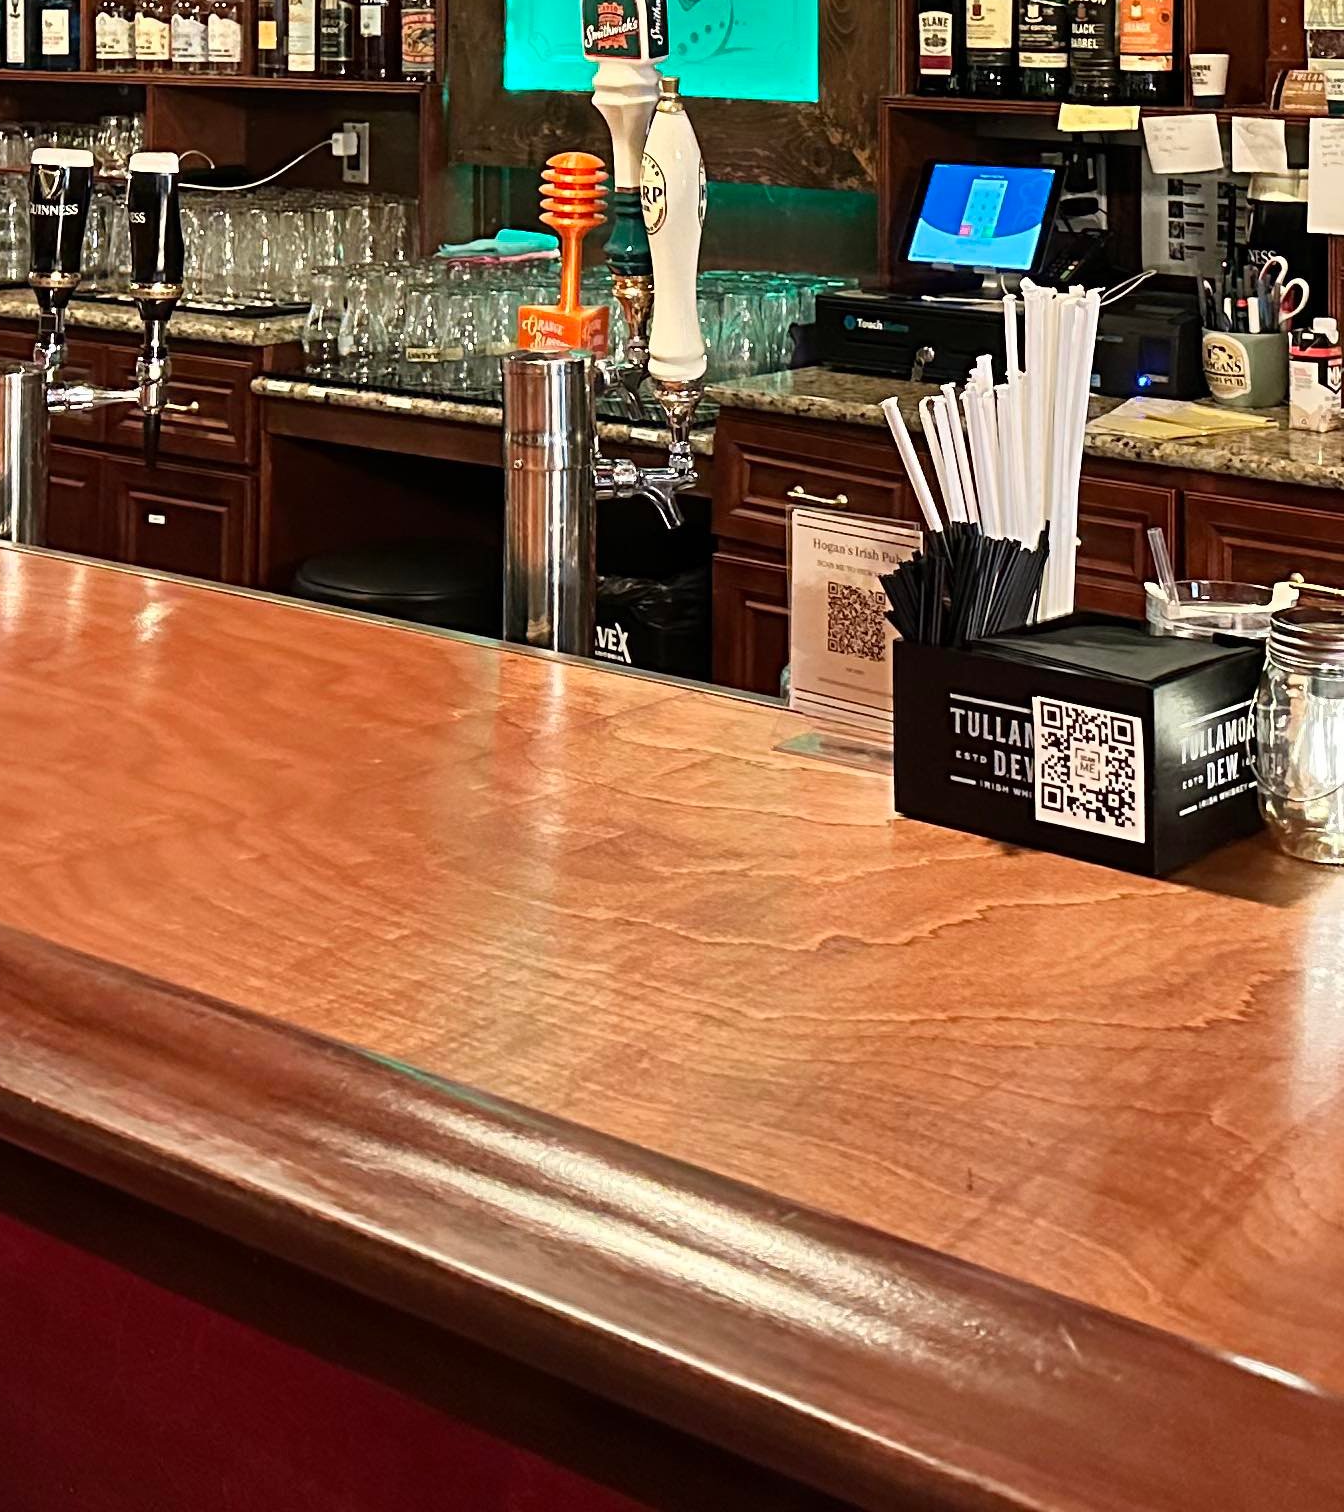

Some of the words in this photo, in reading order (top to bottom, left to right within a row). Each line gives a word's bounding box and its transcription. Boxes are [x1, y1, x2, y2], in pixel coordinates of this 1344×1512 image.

[922, 17, 949, 28] SLANE
[585, 17, 638, 48] Smithwick's
[642, 185, 663, 205] RP
[812, 538, 853, 556] Hogan's
[855, 546, 880, 562] Irish
[882, 552, 903, 565] Pub
[955, 750, 987, 764] ESTD
[1080, 763, 1096, 774] ME
[980, 778, 1010, 794] IRISH
